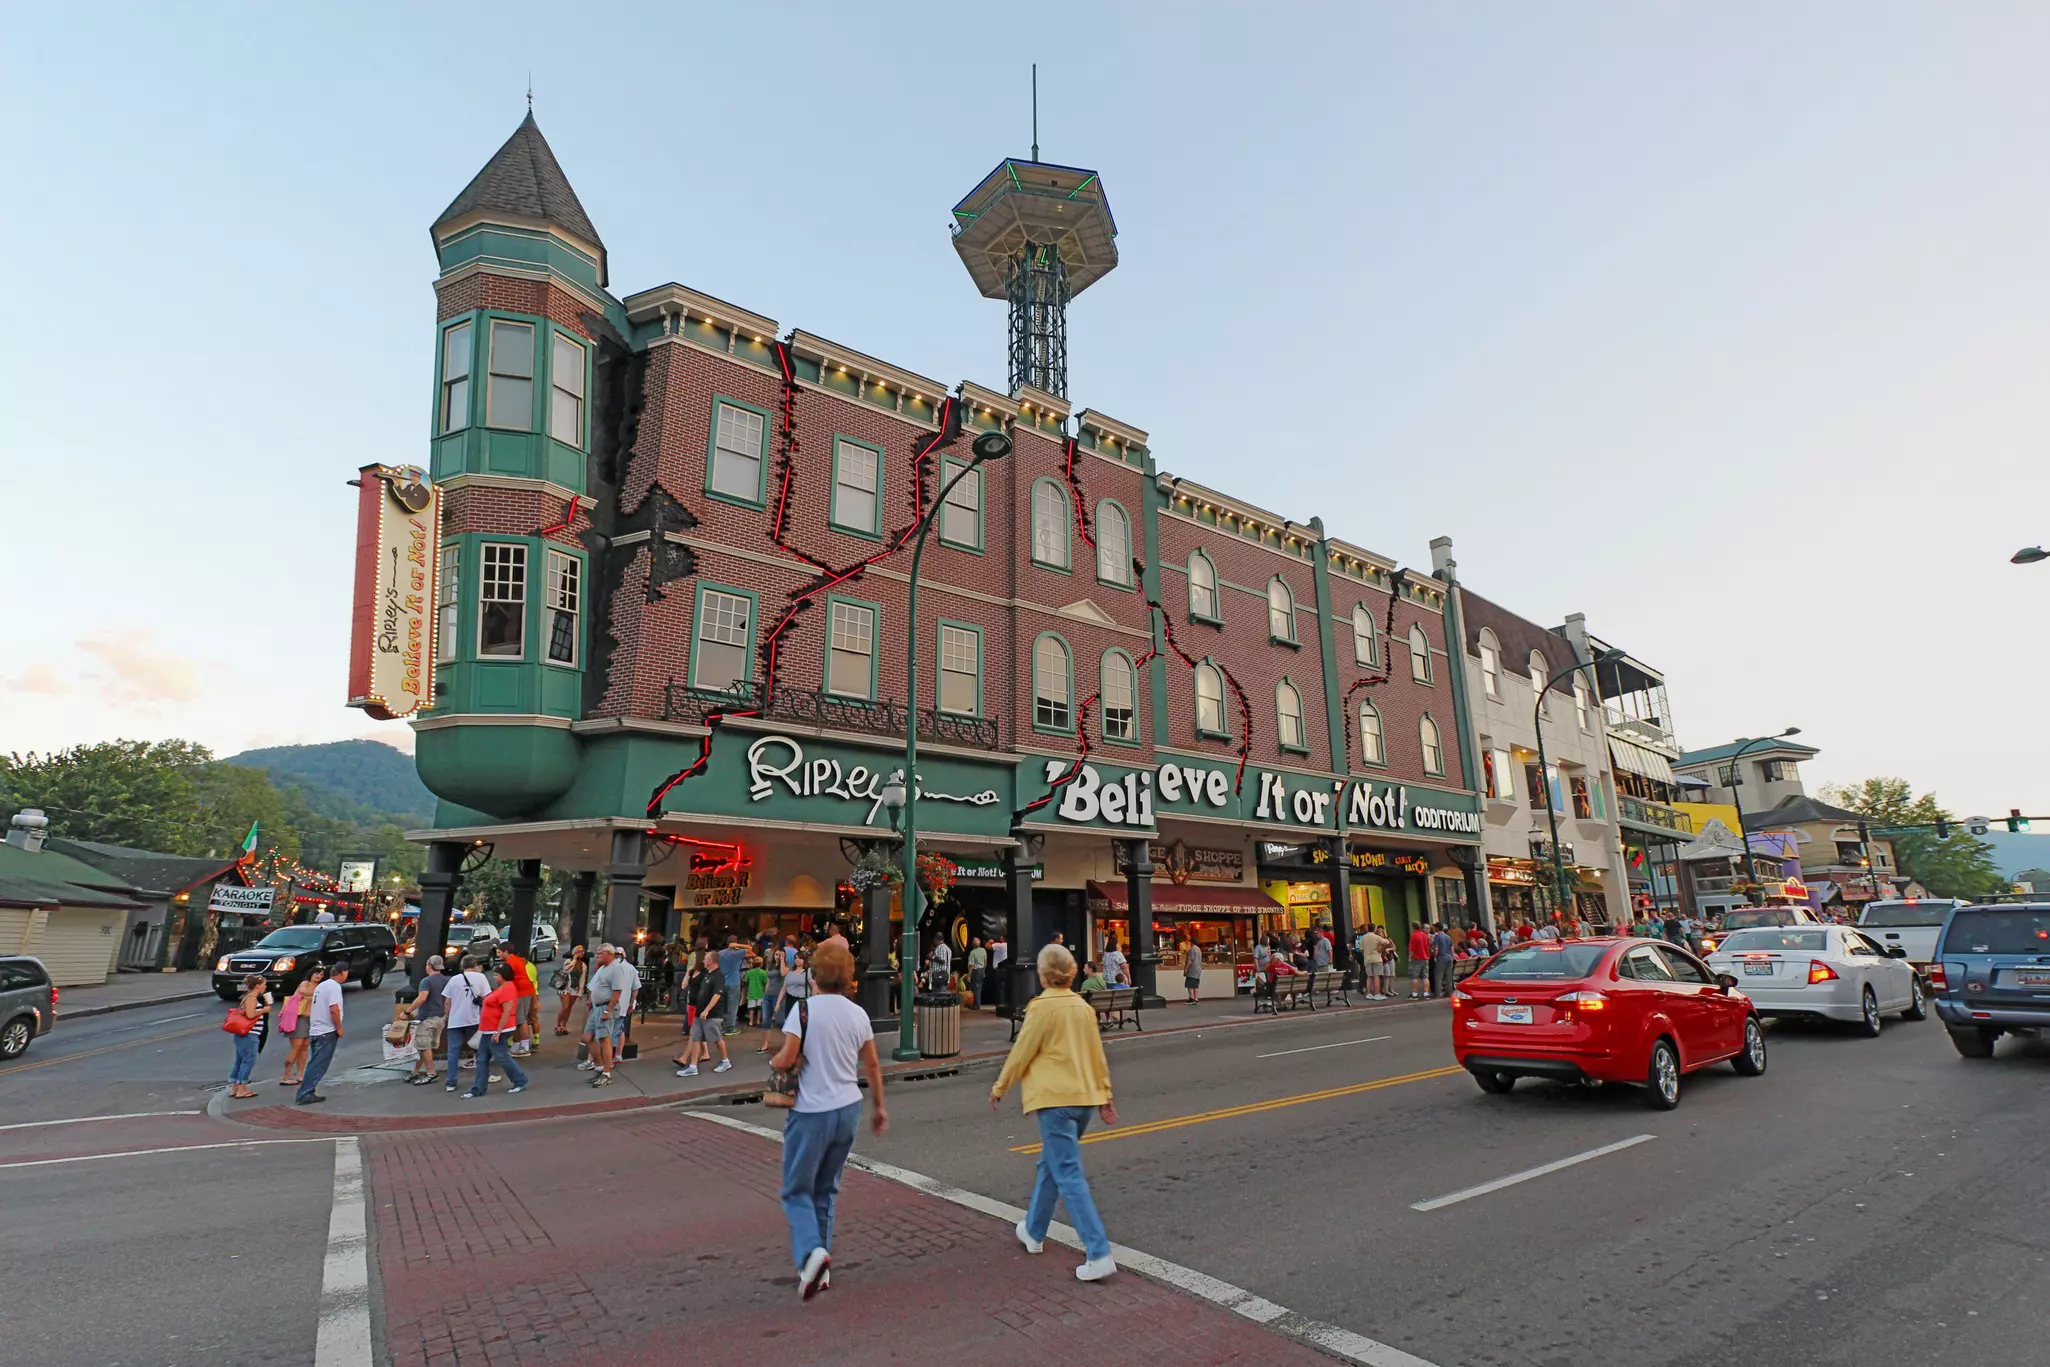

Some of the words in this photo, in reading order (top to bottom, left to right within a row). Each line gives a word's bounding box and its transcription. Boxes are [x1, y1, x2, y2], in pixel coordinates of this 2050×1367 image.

[408, 518, 427, 567] Not!
[411, 567, 425, 591] or
[406, 594, 424, 614] It
[402, 617, 422, 695] Believe
[1256, 772, 1285, 820] It
[1294, 790, 1329, 824] or
[1335, 782, 1408, 829] Not!
[1415, 806, 1480, 833] ODDITORIUM
[1195, 850, 1241, 865] SHOPPE
[1361, 854, 1385, 867] ZONE!
[686, 873, 735, 890] Believe
[736, 871, 750, 888] It
[957, 866, 966, 876] It
[967, 869, 977, 877] or
[978, 867, 997, 877] Not!
[213, 888, 273, 901] KARAOKE
[694, 893, 711, 906] or
[712, 887, 742, 906] Not!
[219, 901, 261, 909] TONIGHT
[1203, 904, 1230, 913] SHOPPE
